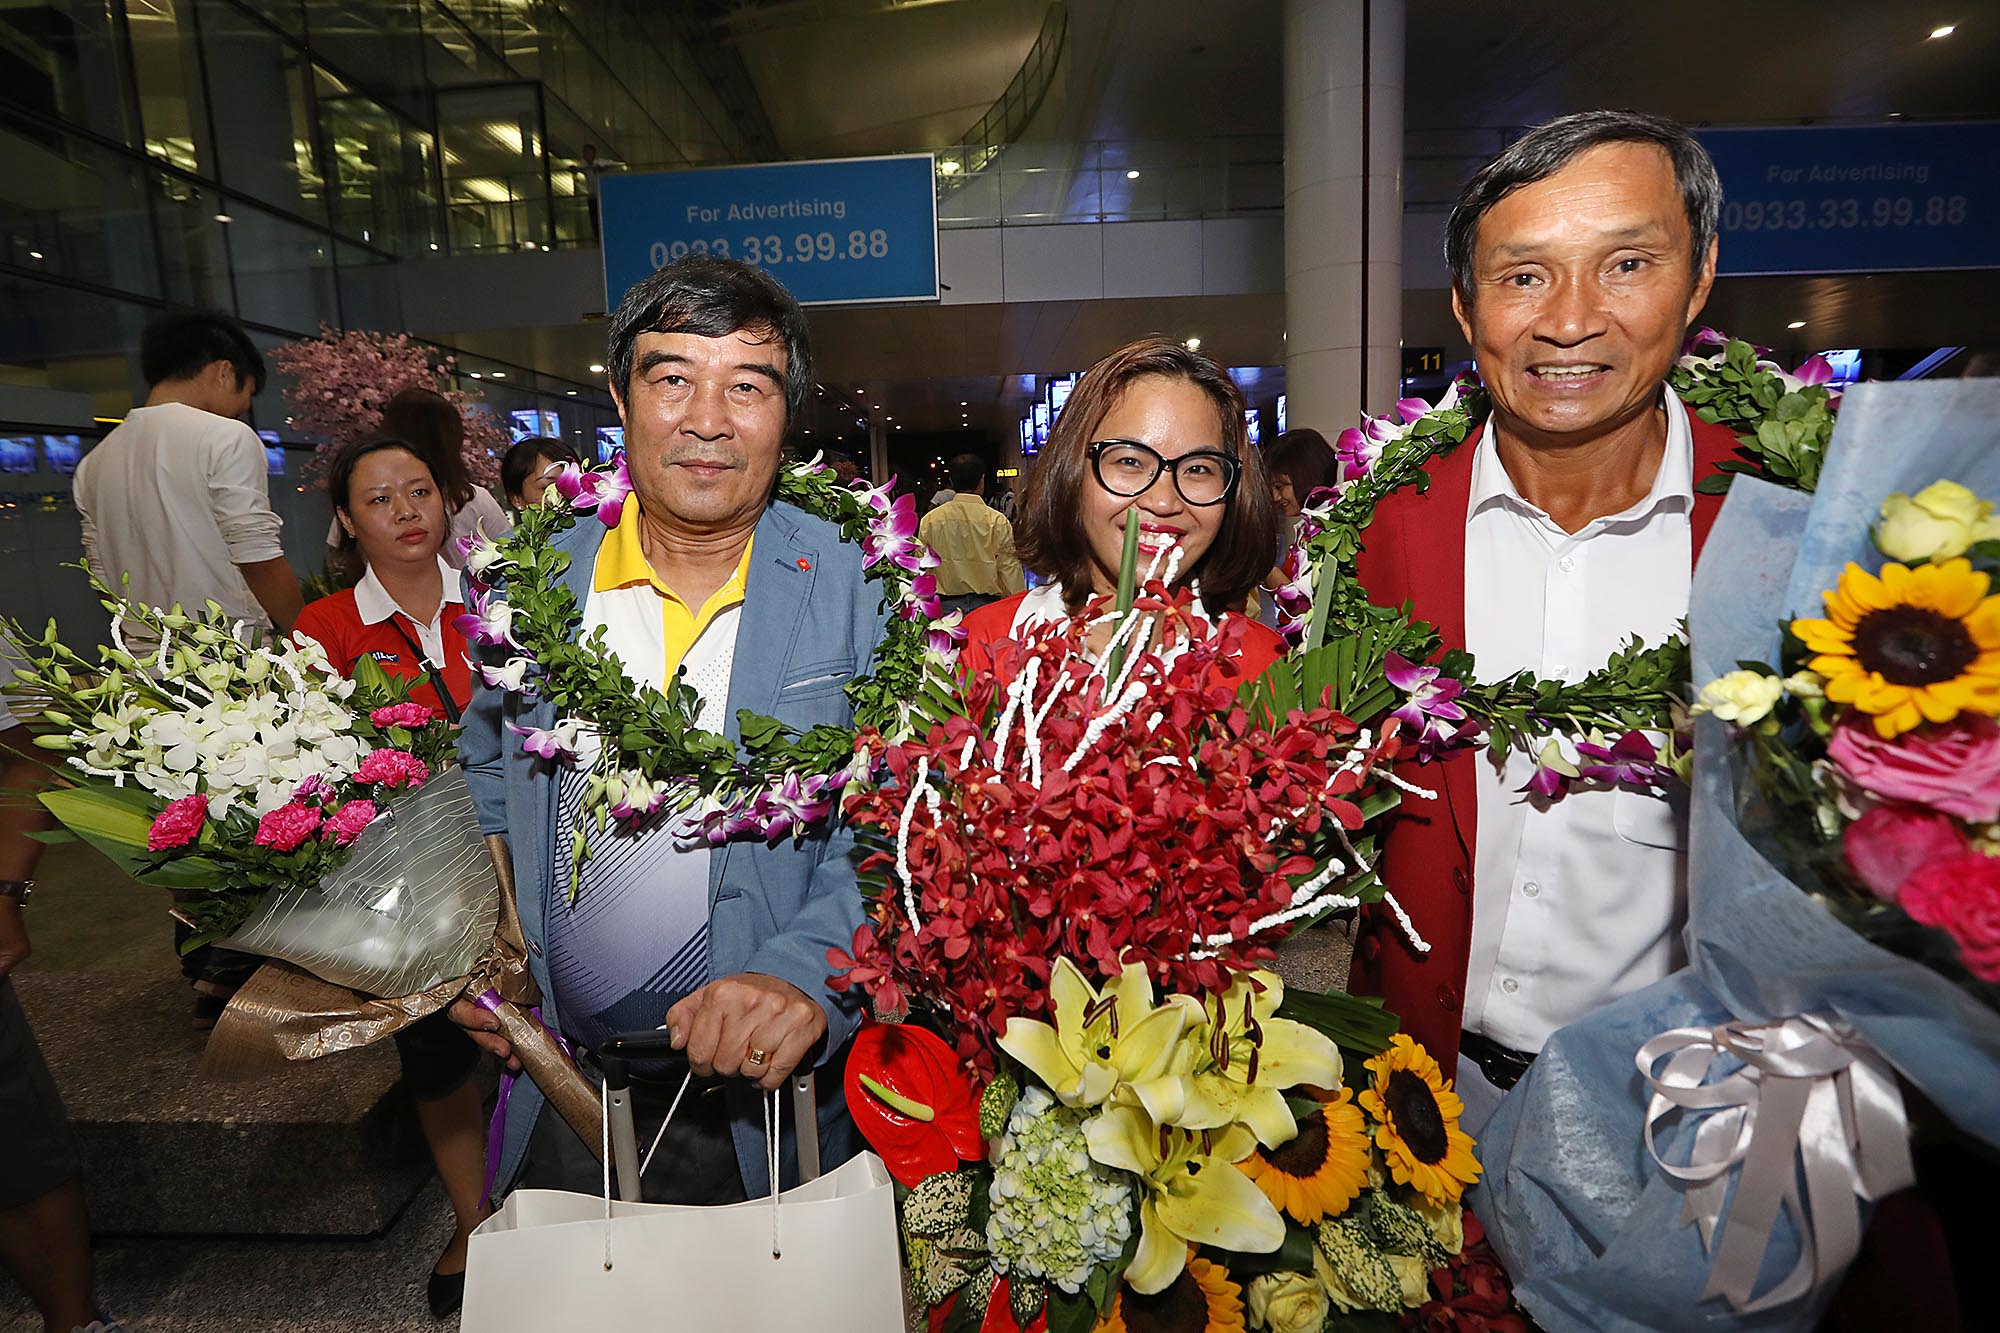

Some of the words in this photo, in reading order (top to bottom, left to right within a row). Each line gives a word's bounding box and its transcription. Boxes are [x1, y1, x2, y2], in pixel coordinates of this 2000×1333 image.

[1766, 164, 1803, 184] For
[1808, 162, 1930, 183] Advertising
[686, 205, 720, 223] For
[727, 198, 847, 221] Advertising
[1723, 195, 1967, 231] 0933.33.99.88
[650, 228, 889, 270] 09333.99.88
[1420, 352, 1441, 371] 11
